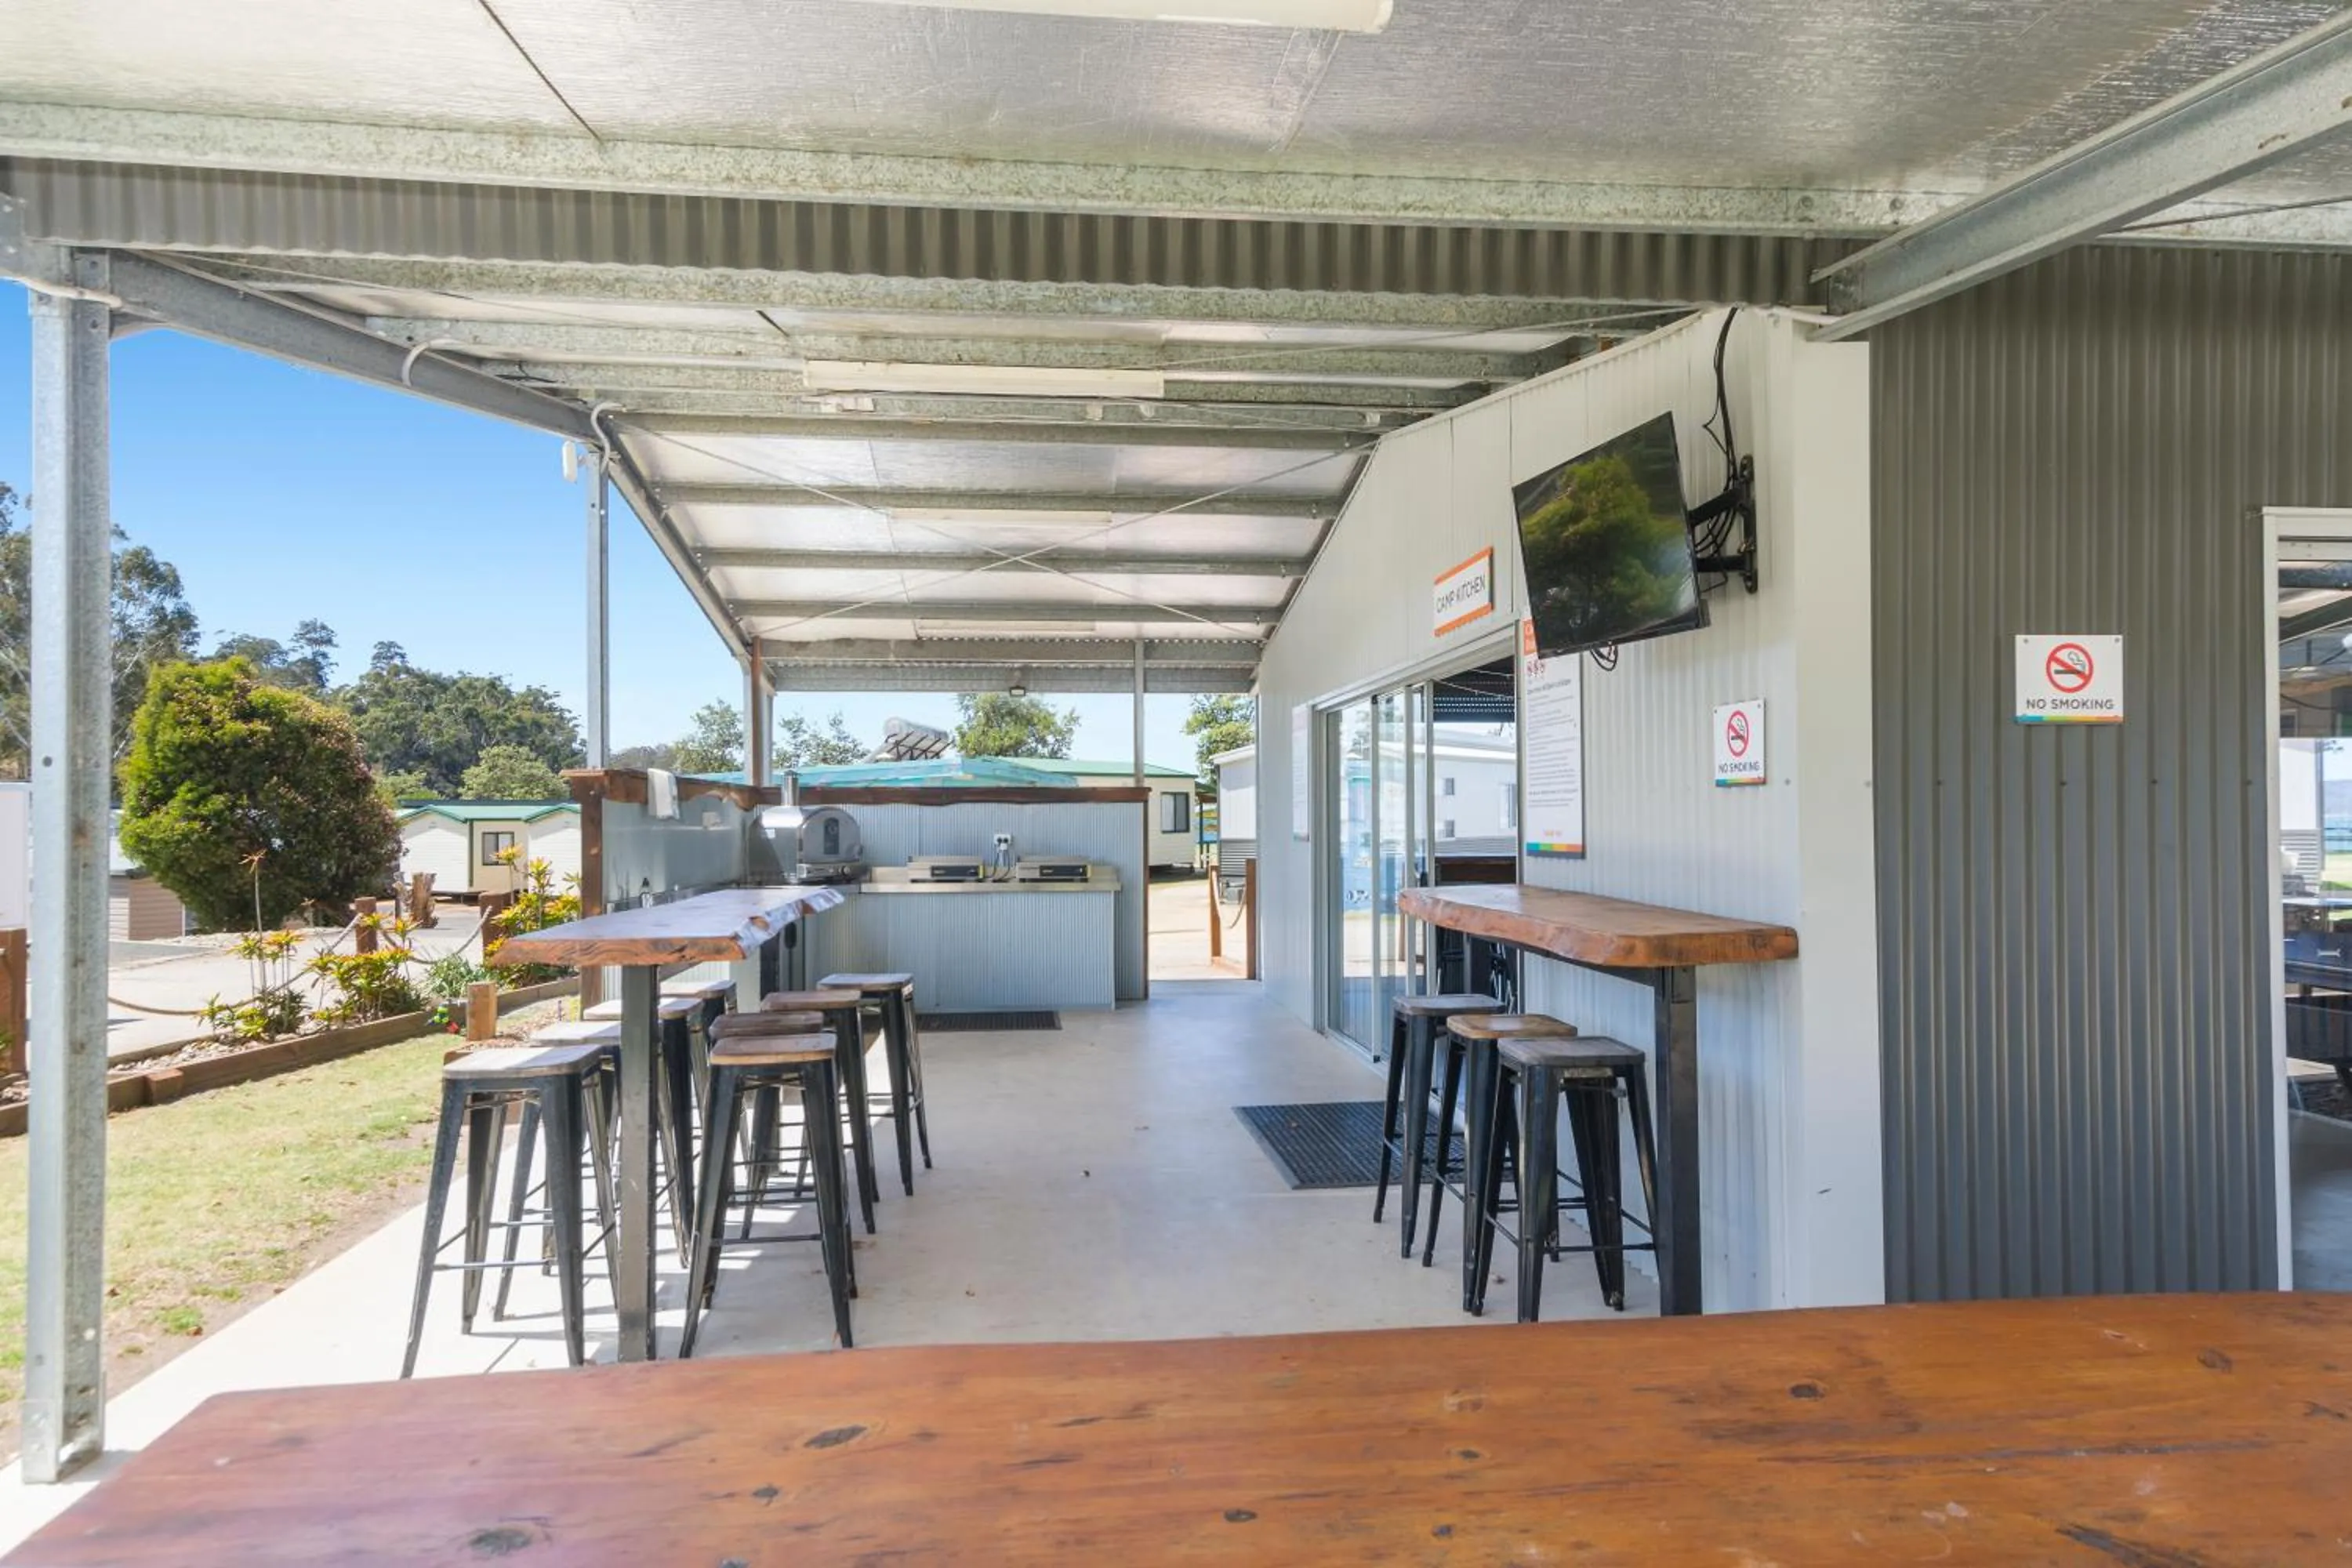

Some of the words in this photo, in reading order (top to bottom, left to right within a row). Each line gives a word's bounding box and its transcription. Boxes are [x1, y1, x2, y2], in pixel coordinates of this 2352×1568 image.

[1436, 590, 1454, 613] CAMP
[1457, 574, 1485, 602] KITCHEN
[2026, 699, 2046, 710] NO
[2050, 699, 2114, 710] SMOKING
[1719, 763, 1728, 773] NO
[1730, 761, 1760, 772] SMOKING
